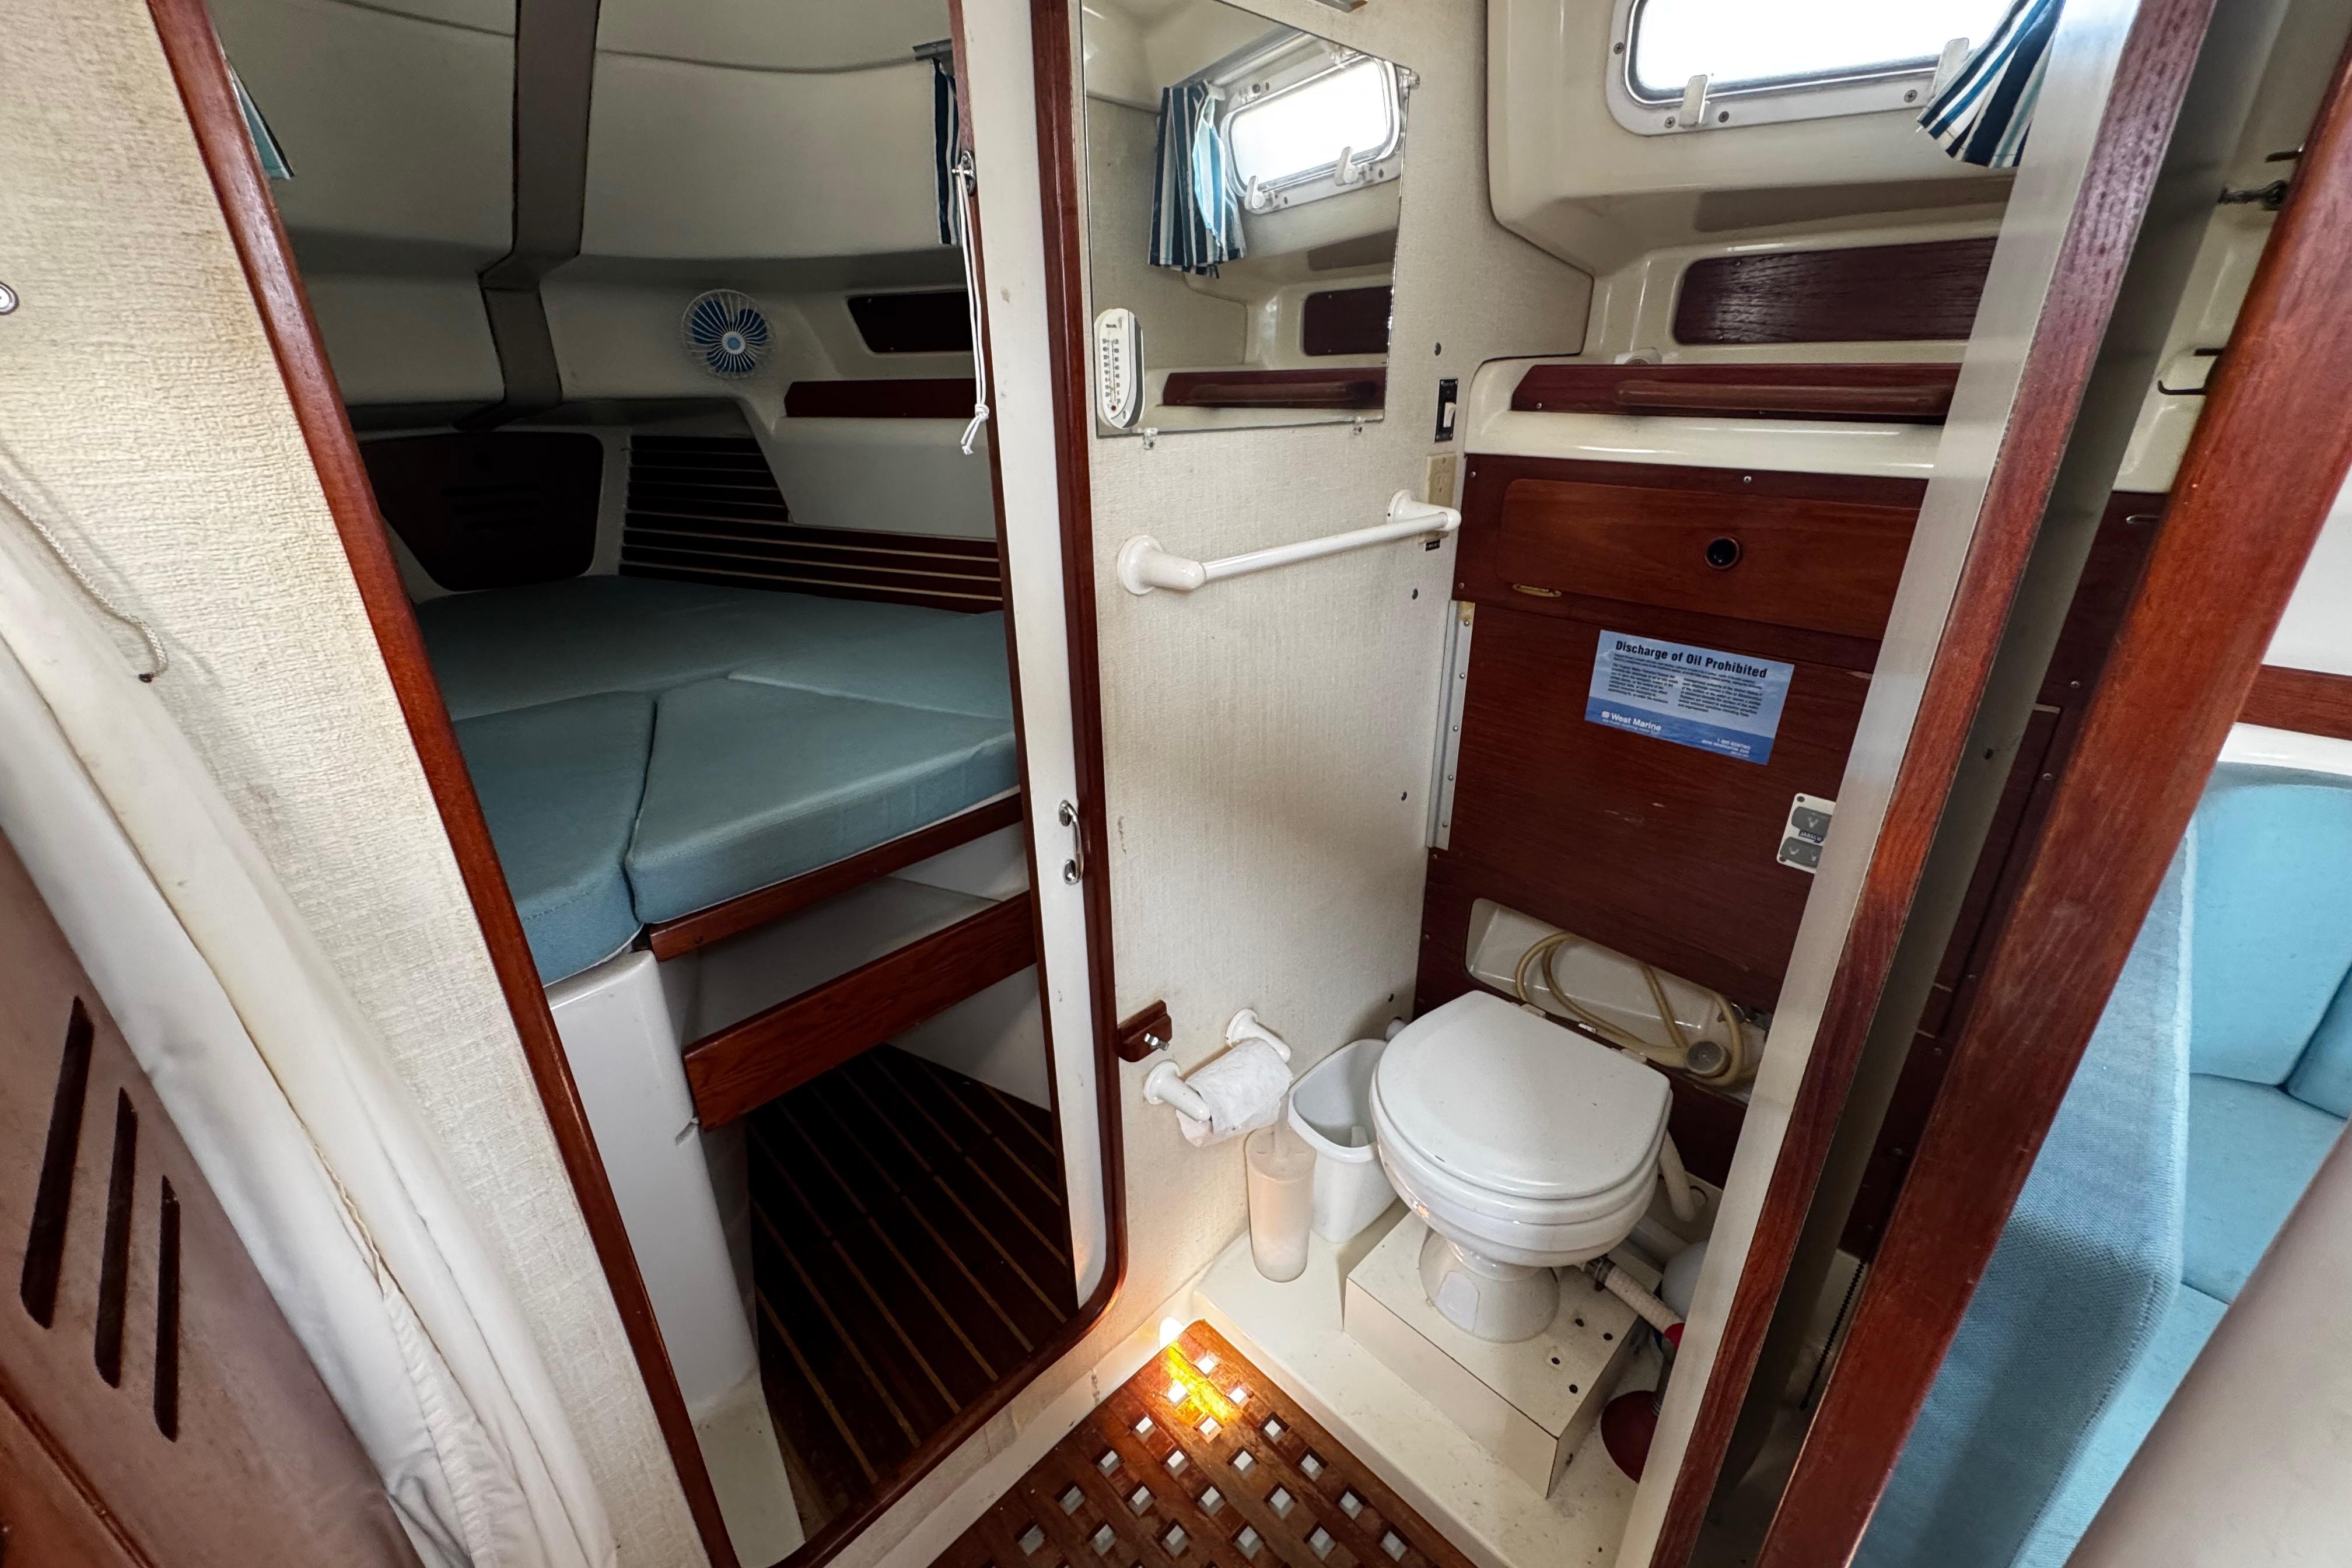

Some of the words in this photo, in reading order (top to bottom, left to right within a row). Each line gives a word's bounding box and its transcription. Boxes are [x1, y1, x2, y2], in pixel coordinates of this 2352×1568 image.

[1615, 640, 1668, 660] Discharge
[1671, 652, 1683, 662] of
[1686, 654, 1701, 666] Oil
[1705, 657, 1768, 678] Prohibited
[1611, 712, 1632, 724] West
[1633, 718, 1662, 732] Marine
